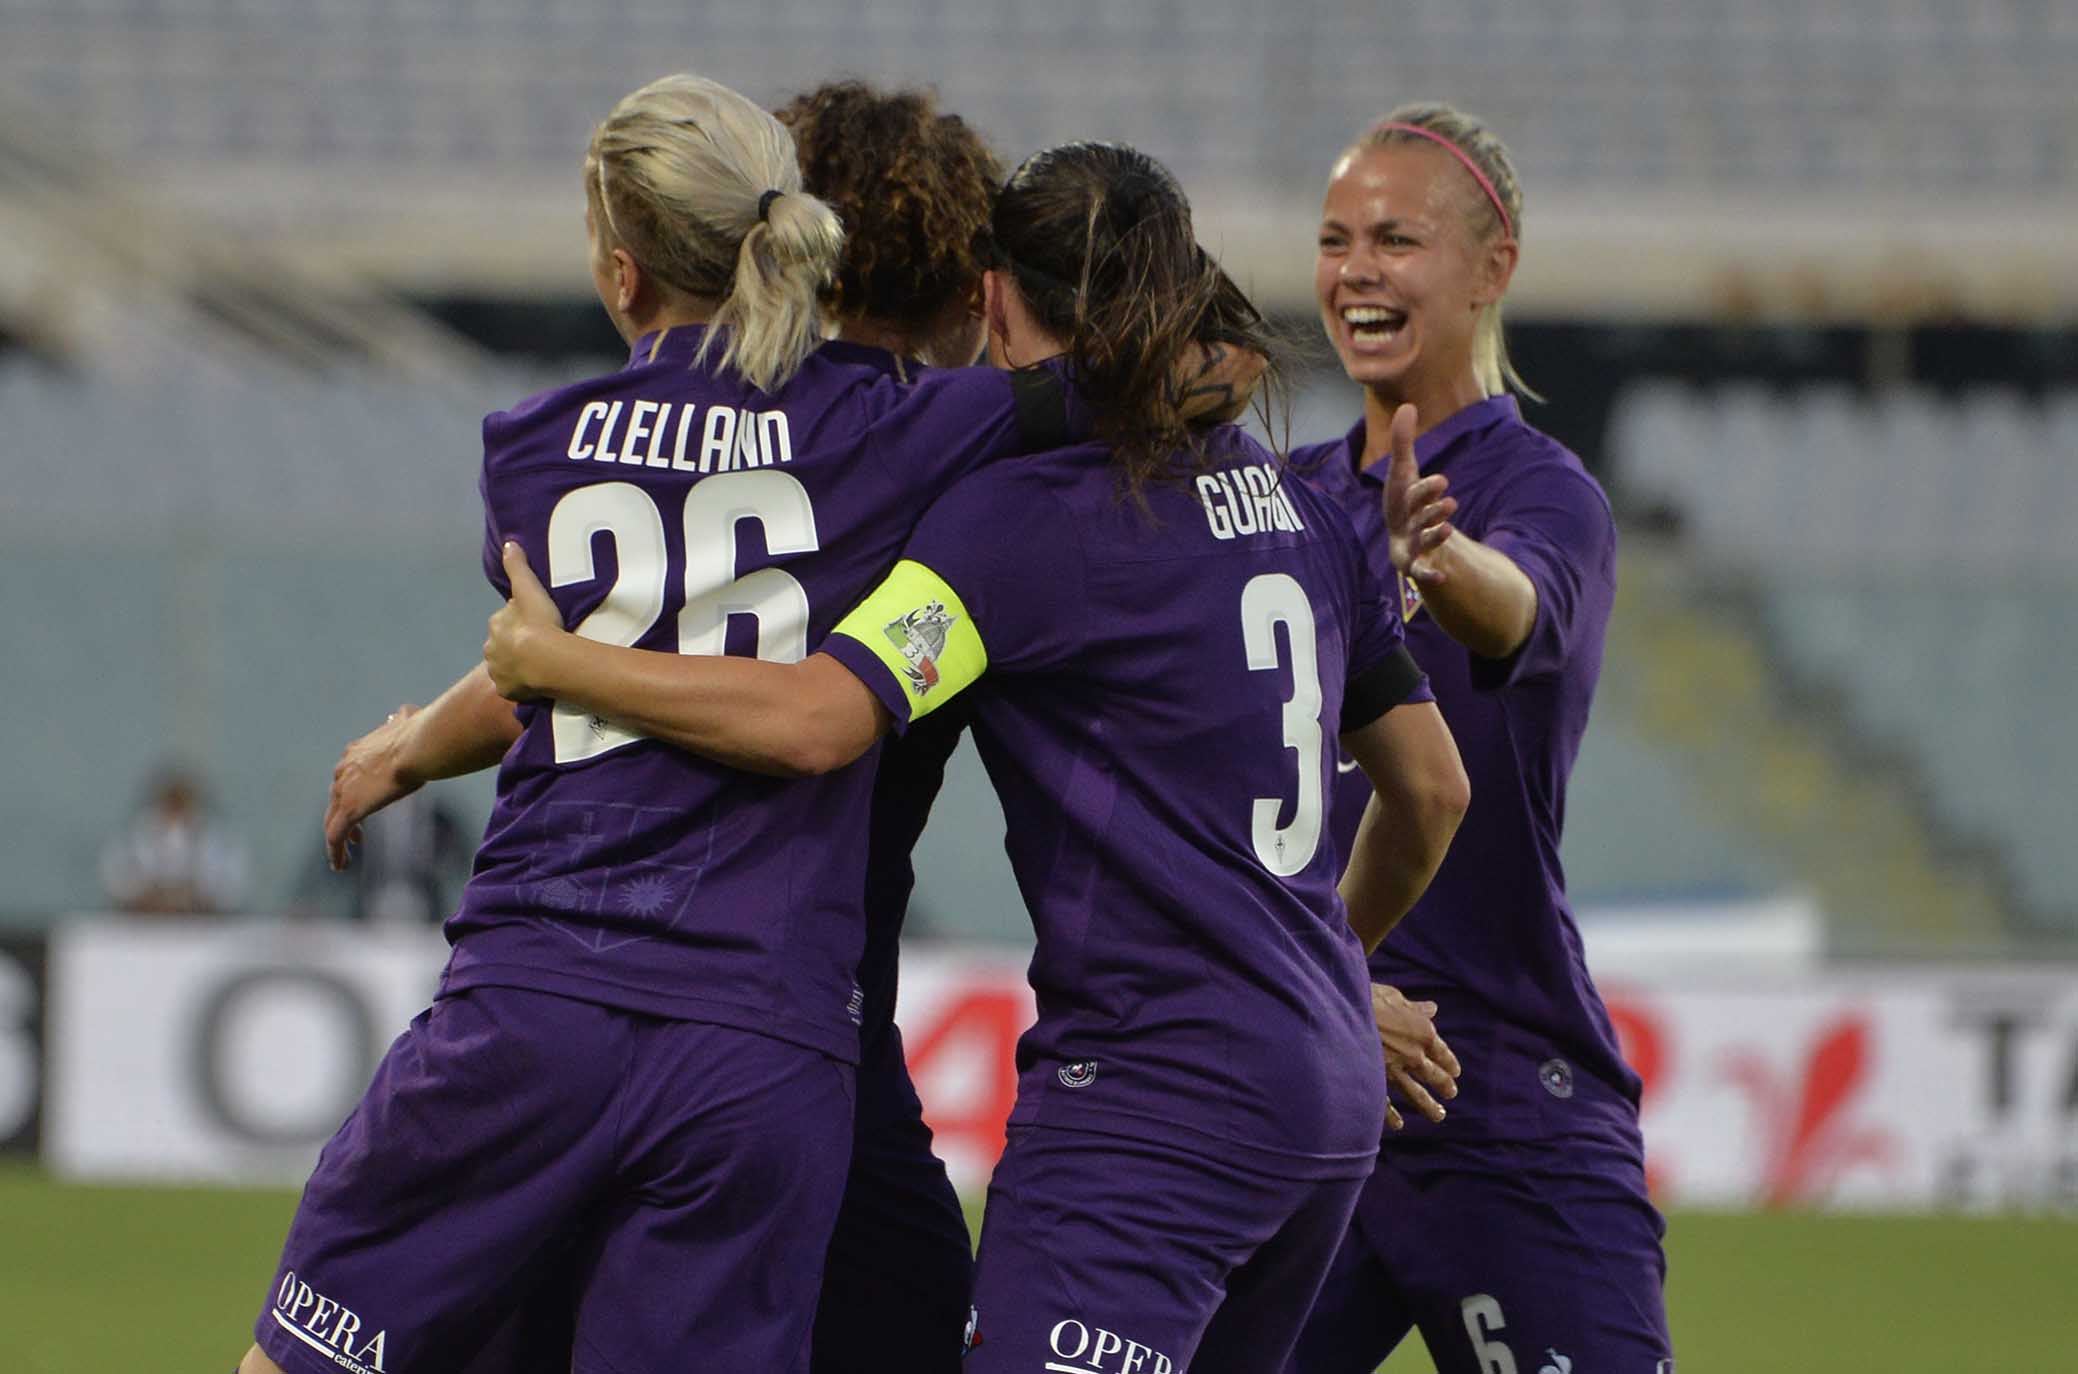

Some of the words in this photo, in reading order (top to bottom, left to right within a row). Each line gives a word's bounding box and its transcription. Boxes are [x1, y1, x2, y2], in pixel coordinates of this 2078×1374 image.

[548, 468, 819, 764] 26
[1241, 573, 1322, 876] 3
[276, 1271, 386, 1374] OPERA
[1050, 1319, 1182, 1374] OPER
